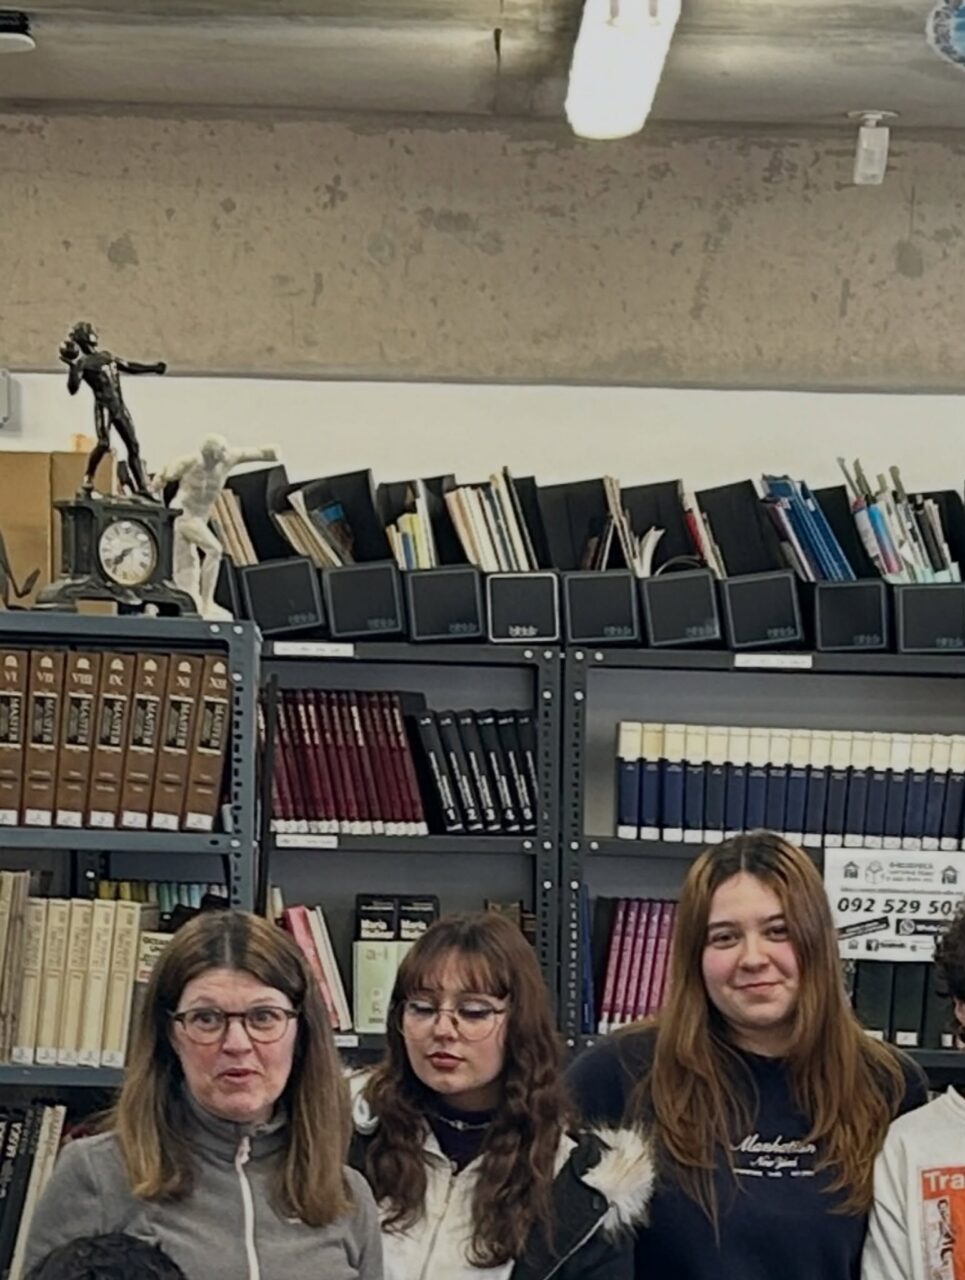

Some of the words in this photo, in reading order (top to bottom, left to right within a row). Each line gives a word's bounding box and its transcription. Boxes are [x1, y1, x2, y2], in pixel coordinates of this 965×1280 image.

[447, 809, 455, 820] 1
[467, 809, 477, 820] 2
[486, 809, 496, 820] 3
[505, 809, 515, 820] 4
[837, 898, 875, 912] 092
[882, 899, 920, 913] 529
